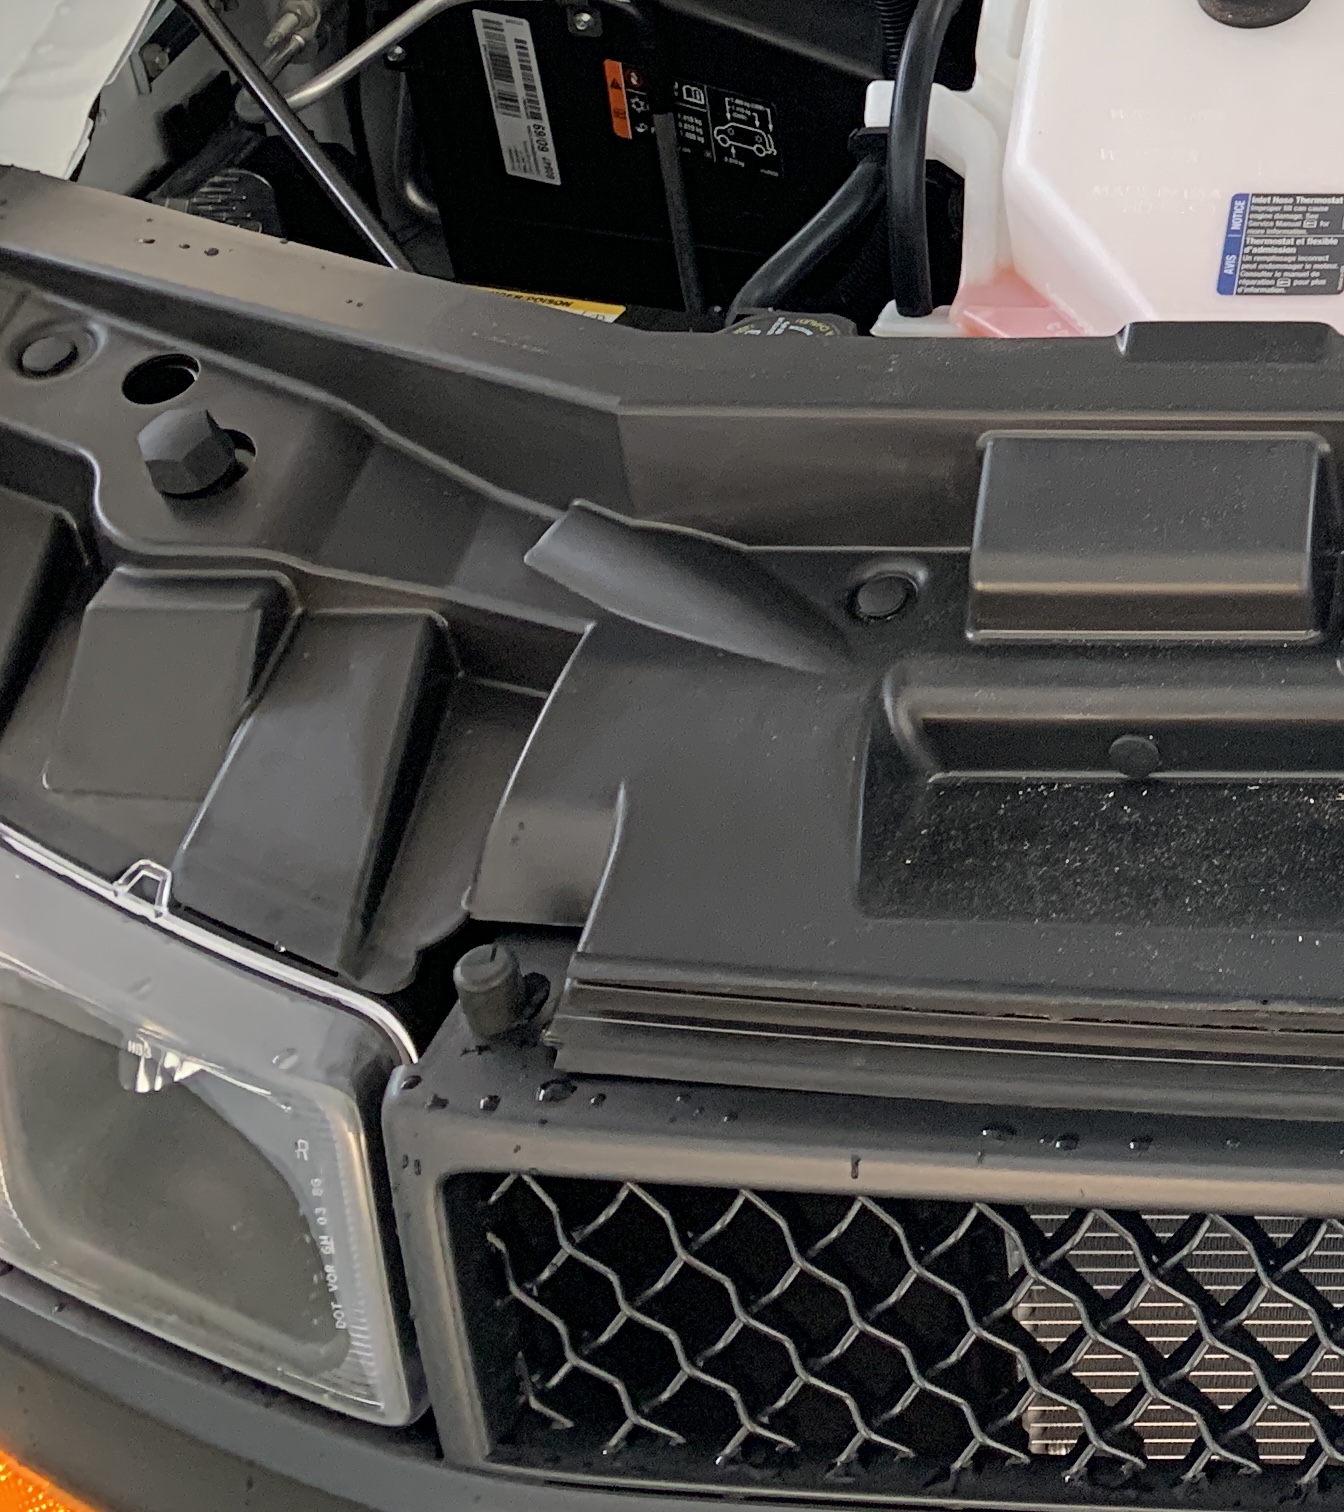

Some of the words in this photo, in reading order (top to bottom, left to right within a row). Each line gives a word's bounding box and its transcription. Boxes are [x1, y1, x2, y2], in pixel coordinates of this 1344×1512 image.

[1296, 196, 1344, 204] Thermostat
[1230, 200, 1246, 231] NOTICE
[1223, 255, 1237, 275] AVIS
[319, 1234, 335, 1255] GM
[324, 1264, 339, 1293] VOR
[331, 1301, 347, 1329] DOT
